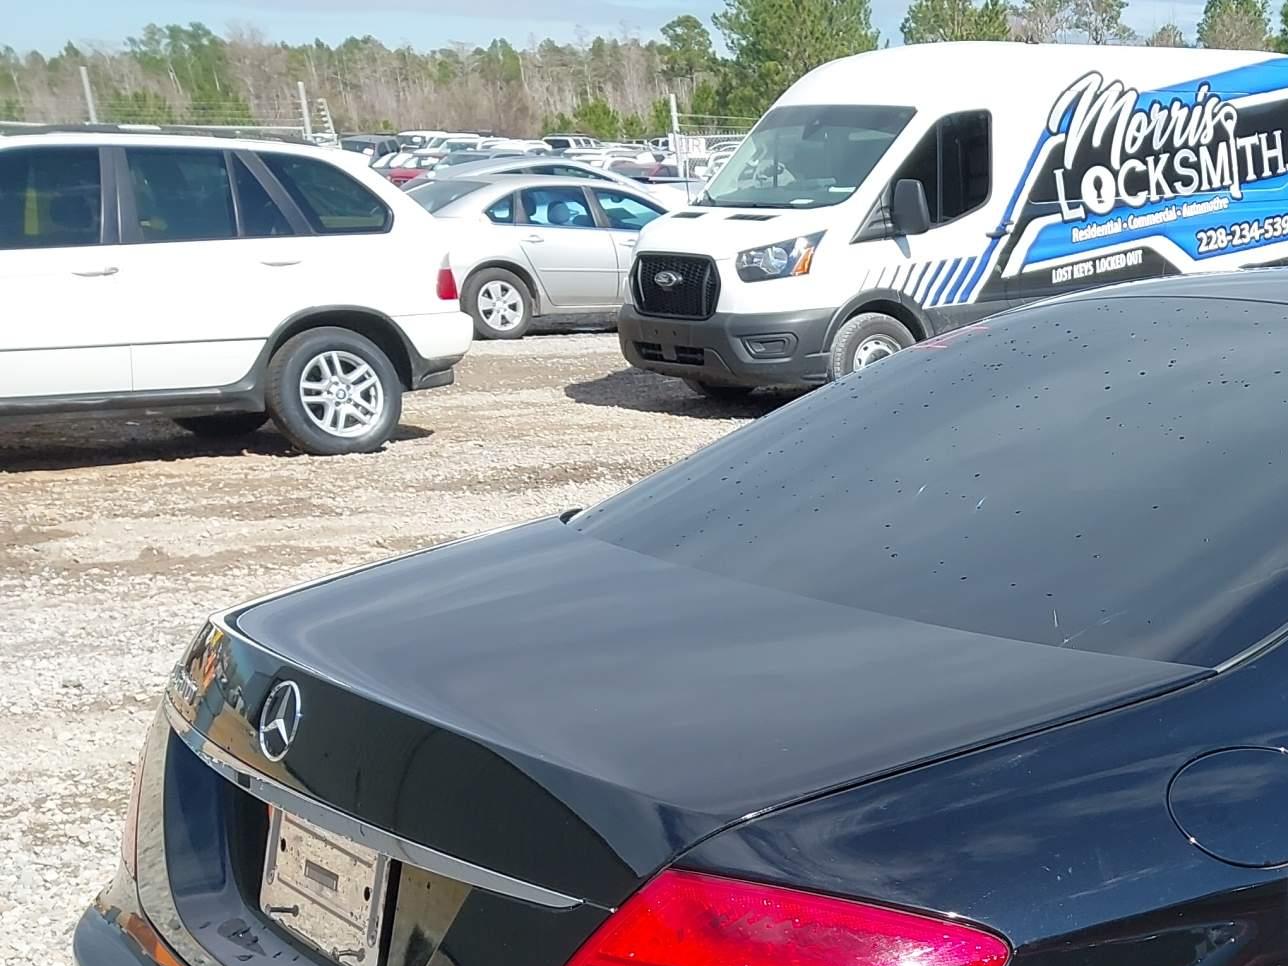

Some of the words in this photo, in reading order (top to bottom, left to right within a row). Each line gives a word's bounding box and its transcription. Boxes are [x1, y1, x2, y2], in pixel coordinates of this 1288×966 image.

[1049, 70, 1224, 169] Morris
[1053, 104, 1287, 223] LOCKSMITH
[1072, 216, 1122, 243] Residential
[1127, 204, 1176, 230] Commercial
[1182, 196, 1229, 217] Automotive
[1052, 266, 1073, 284] LOST
[1073, 261, 1094, 279] KEYS
[1096, 254, 1126, 274] LOCKED
[1127, 249, 1143, 266] OUT
